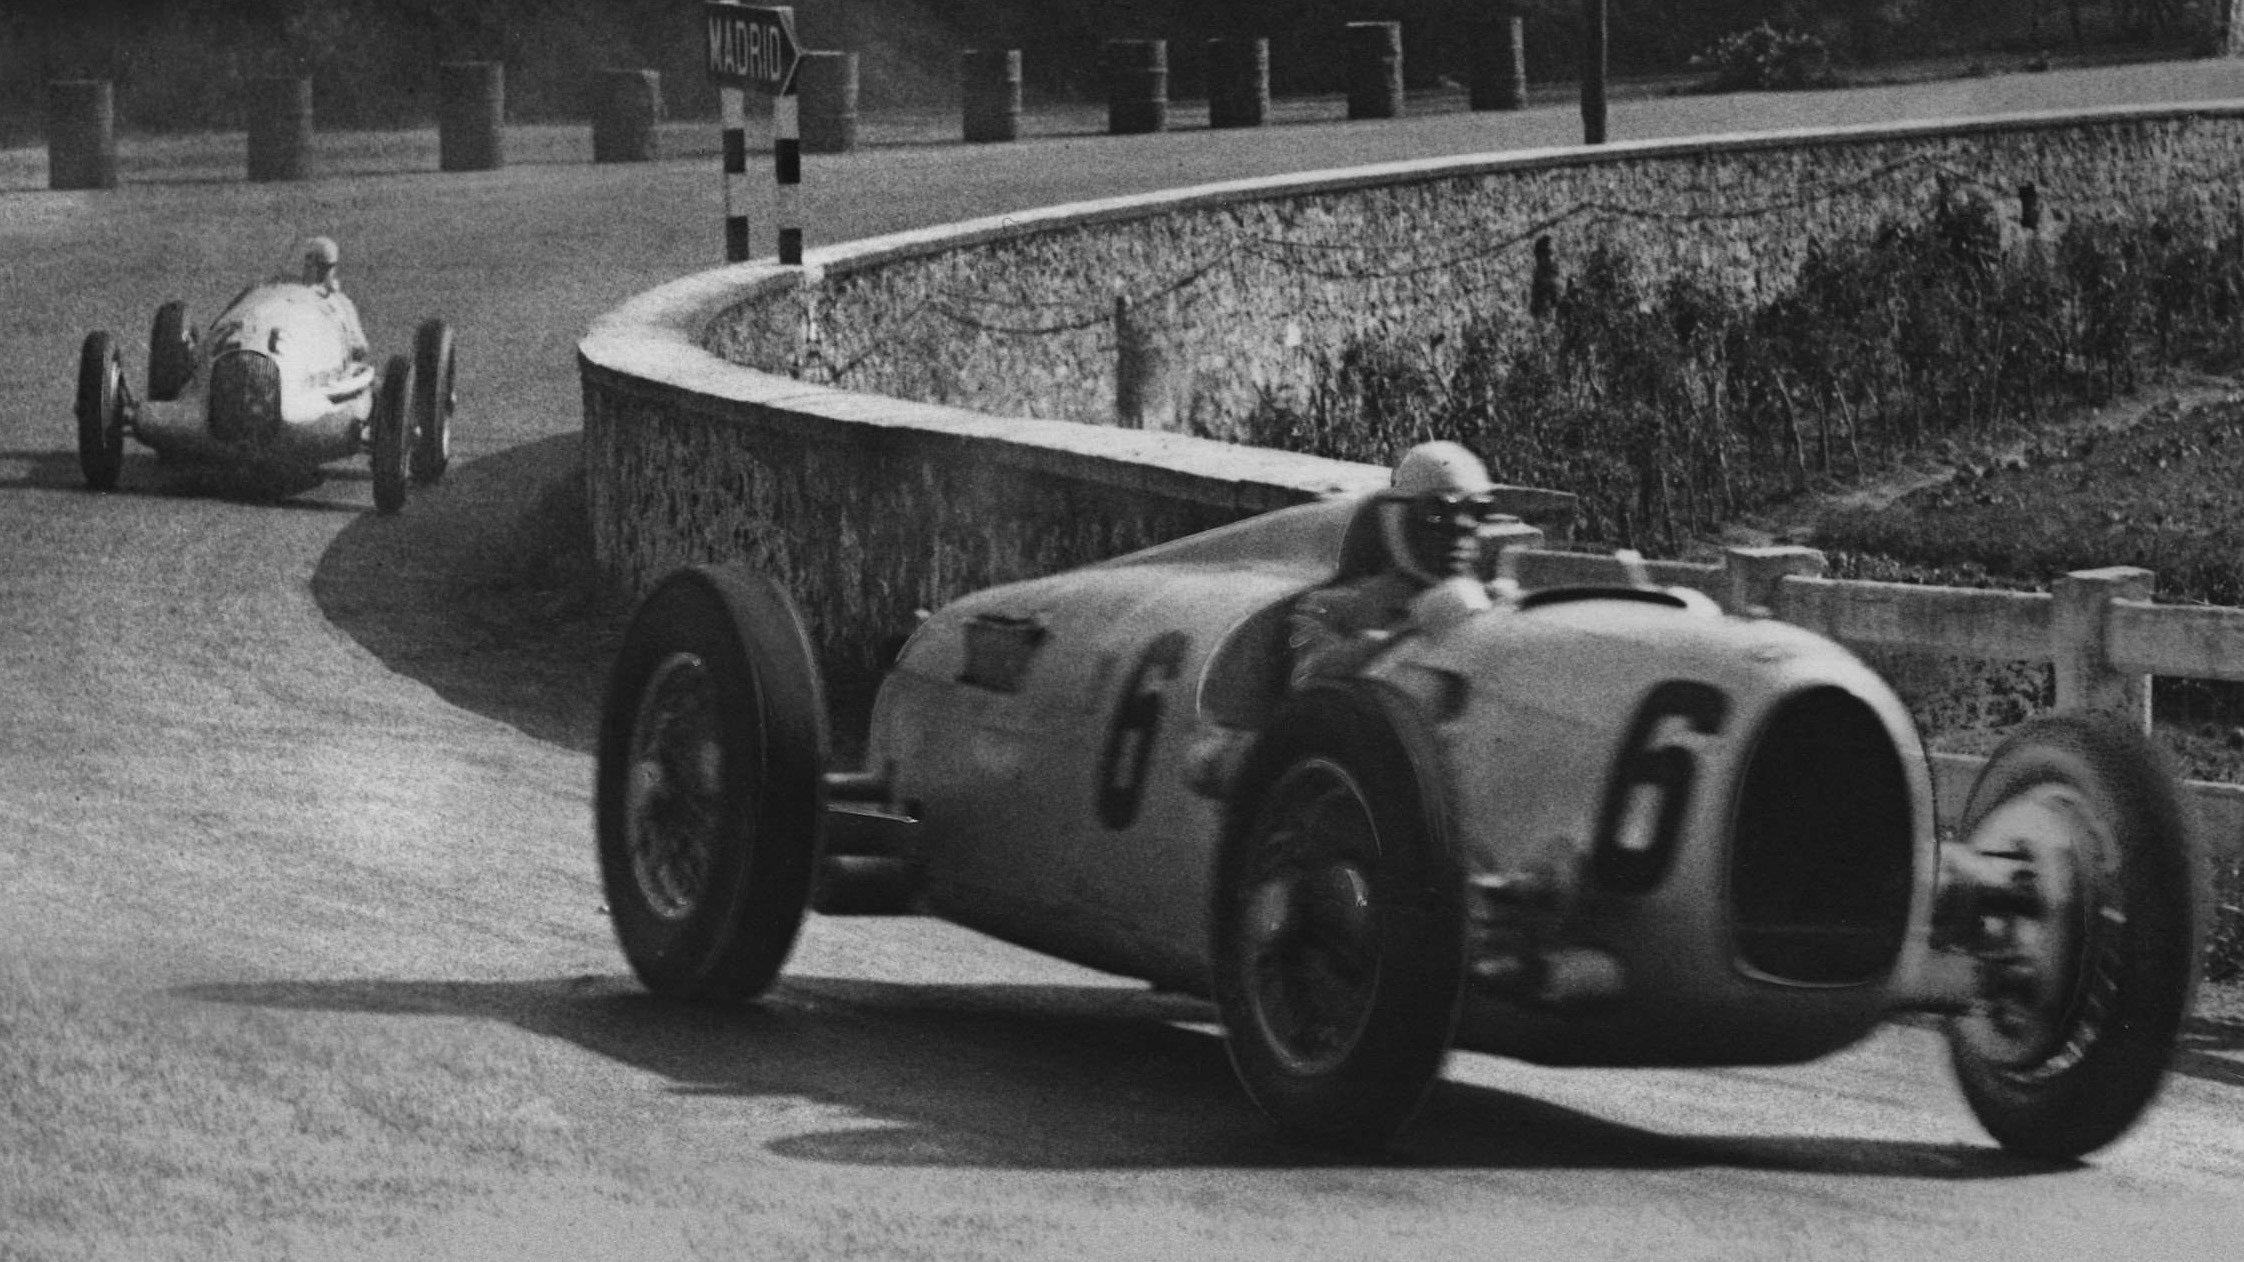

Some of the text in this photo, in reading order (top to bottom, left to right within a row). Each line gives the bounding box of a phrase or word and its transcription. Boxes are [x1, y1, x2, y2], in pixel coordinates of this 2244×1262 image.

[709, 17, 781, 80] MADRID
[1099, 630, 1191, 831] 6
[1594, 679, 1732, 894] 6
